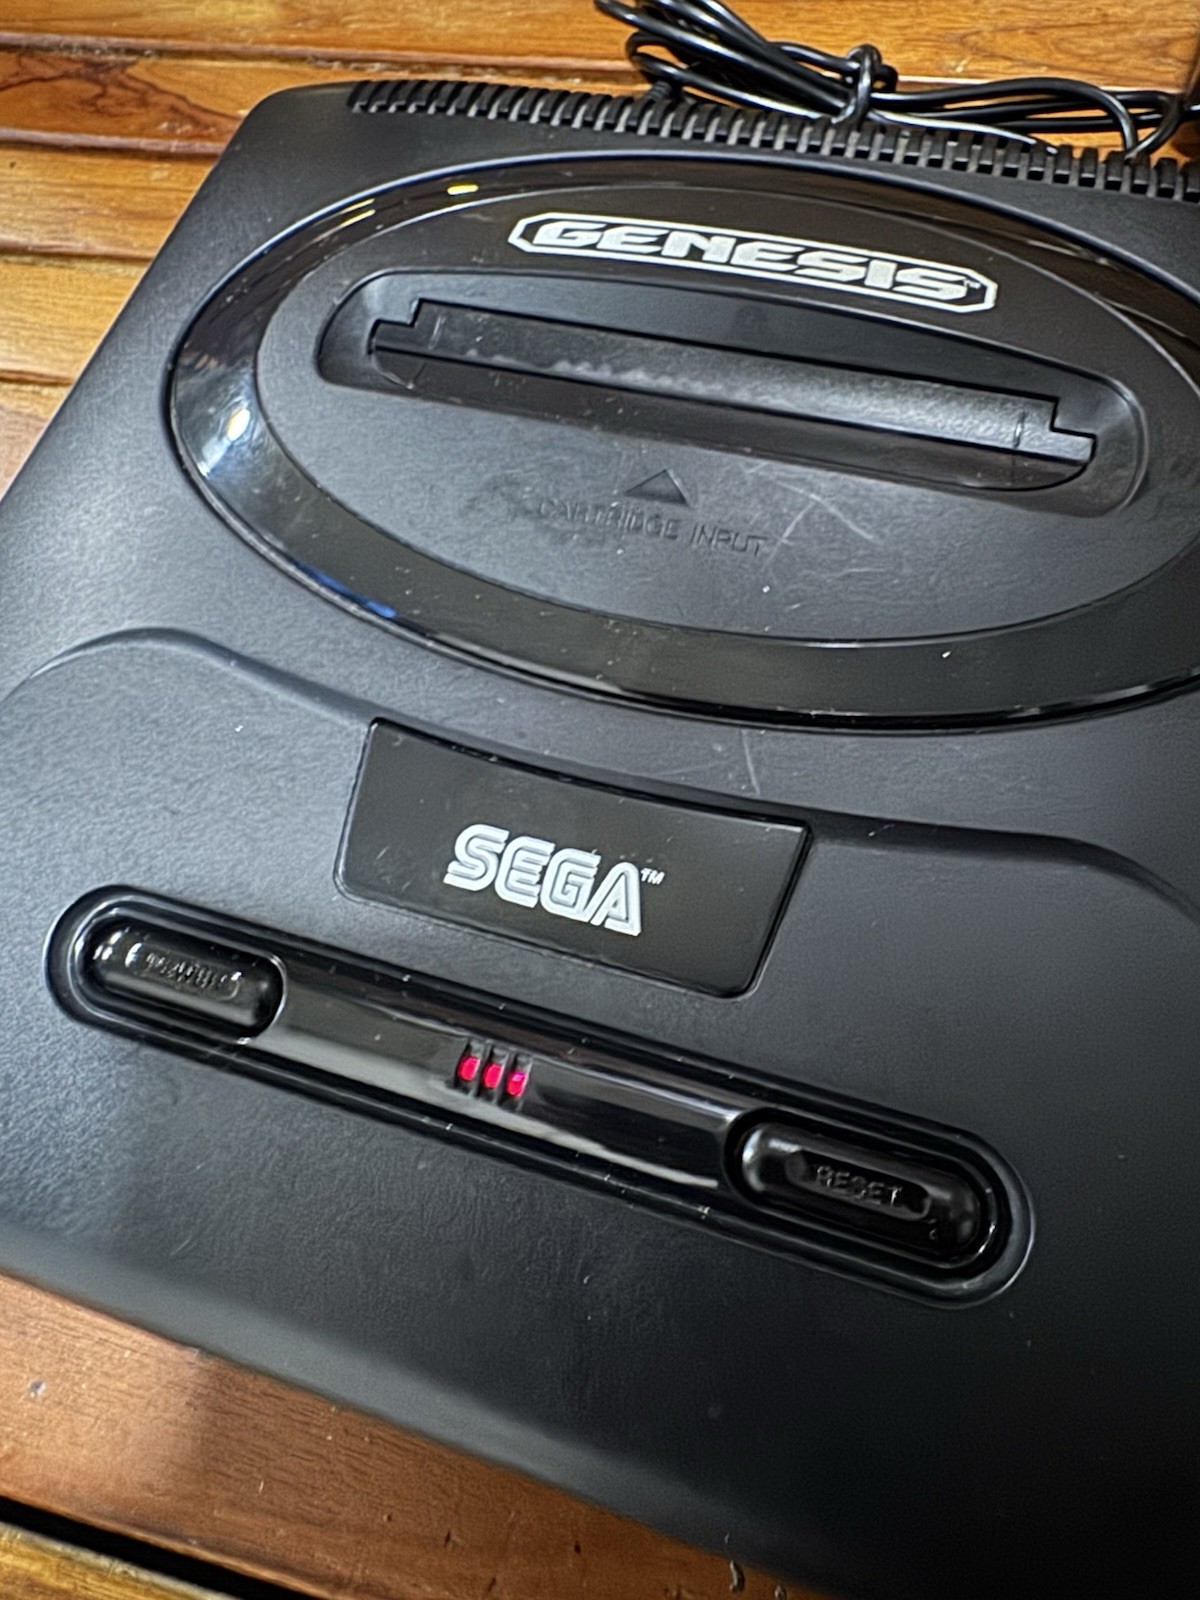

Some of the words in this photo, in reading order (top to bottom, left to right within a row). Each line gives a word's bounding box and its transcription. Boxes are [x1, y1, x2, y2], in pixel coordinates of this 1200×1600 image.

[532, 220, 968, 300] GENESIS
[689, 522, 768, 557] INPUT
[443, 823, 642, 937] SEGA
[814, 1164, 903, 1208] RESET
